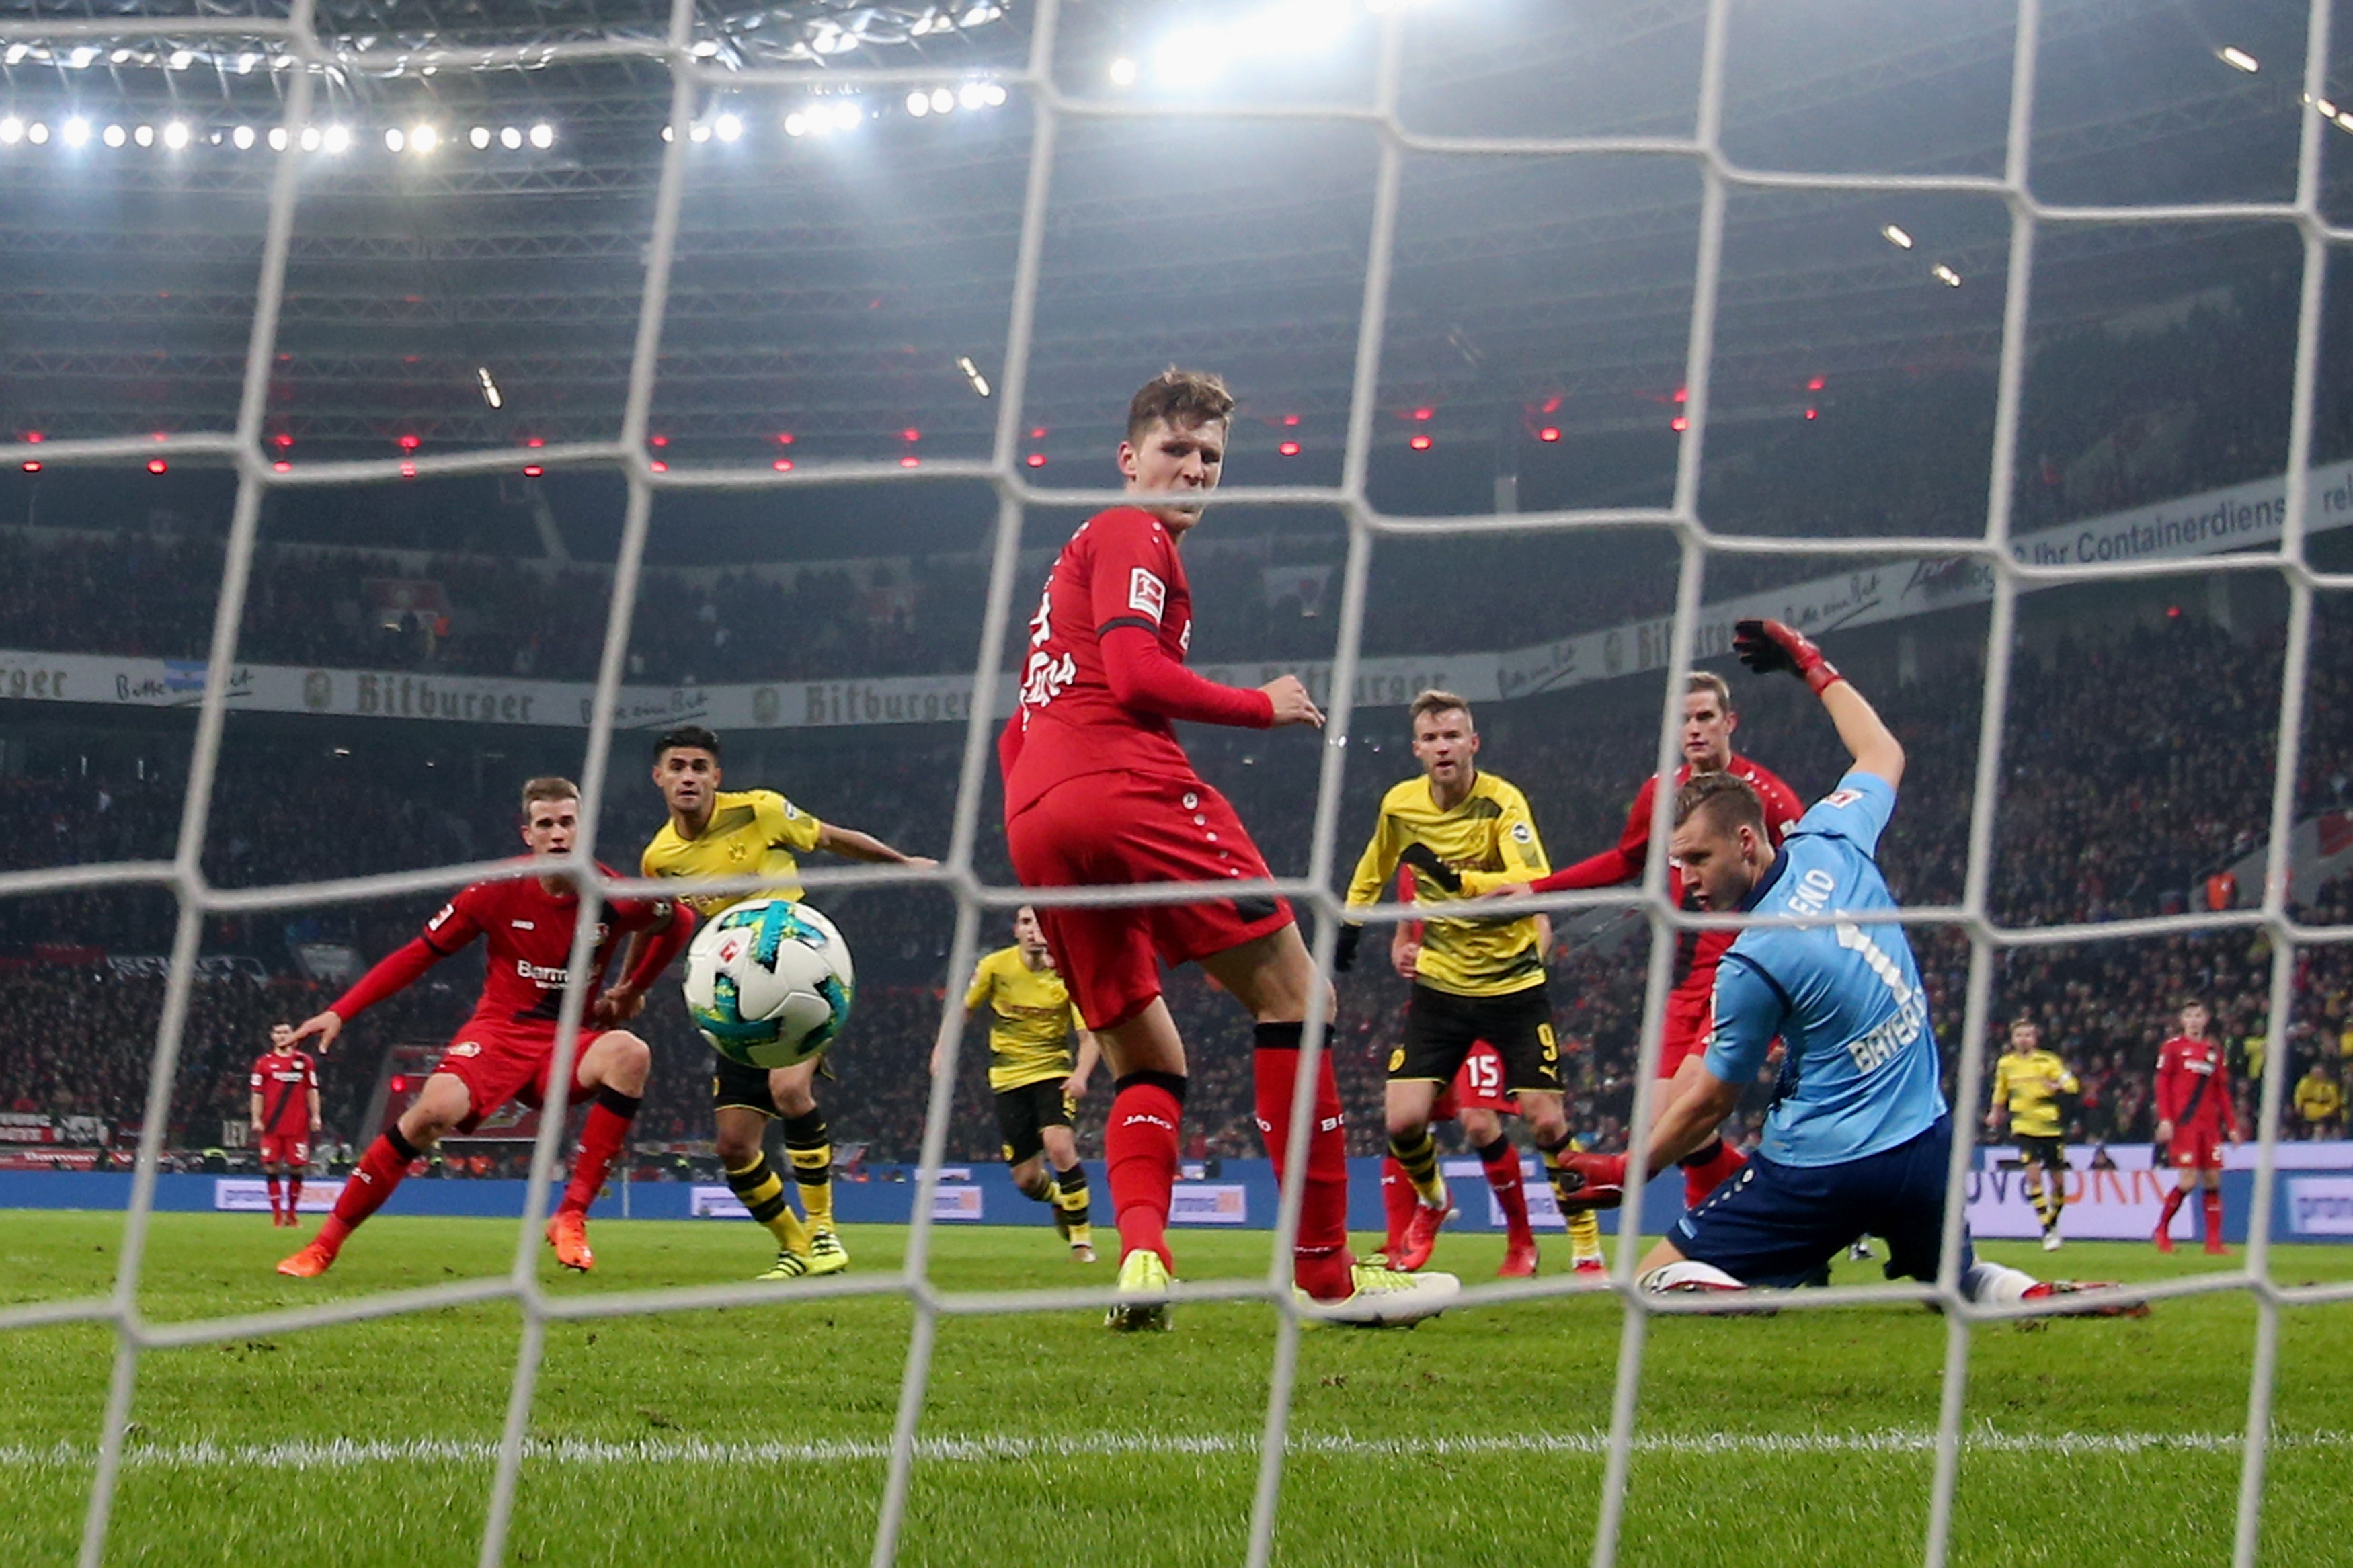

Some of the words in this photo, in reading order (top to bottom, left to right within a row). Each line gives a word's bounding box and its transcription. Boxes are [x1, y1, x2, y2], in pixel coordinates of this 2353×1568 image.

[2077, 497, 2286, 563] Containerdiens
[354, 671, 534, 722] Bitburger
[1778, 868, 1835, 931] LENO
[1538, 1022, 1560, 1063] 9
[1466, 1055, 1499, 1088] 15
[1123, 1113, 1172, 1130] JAKO
